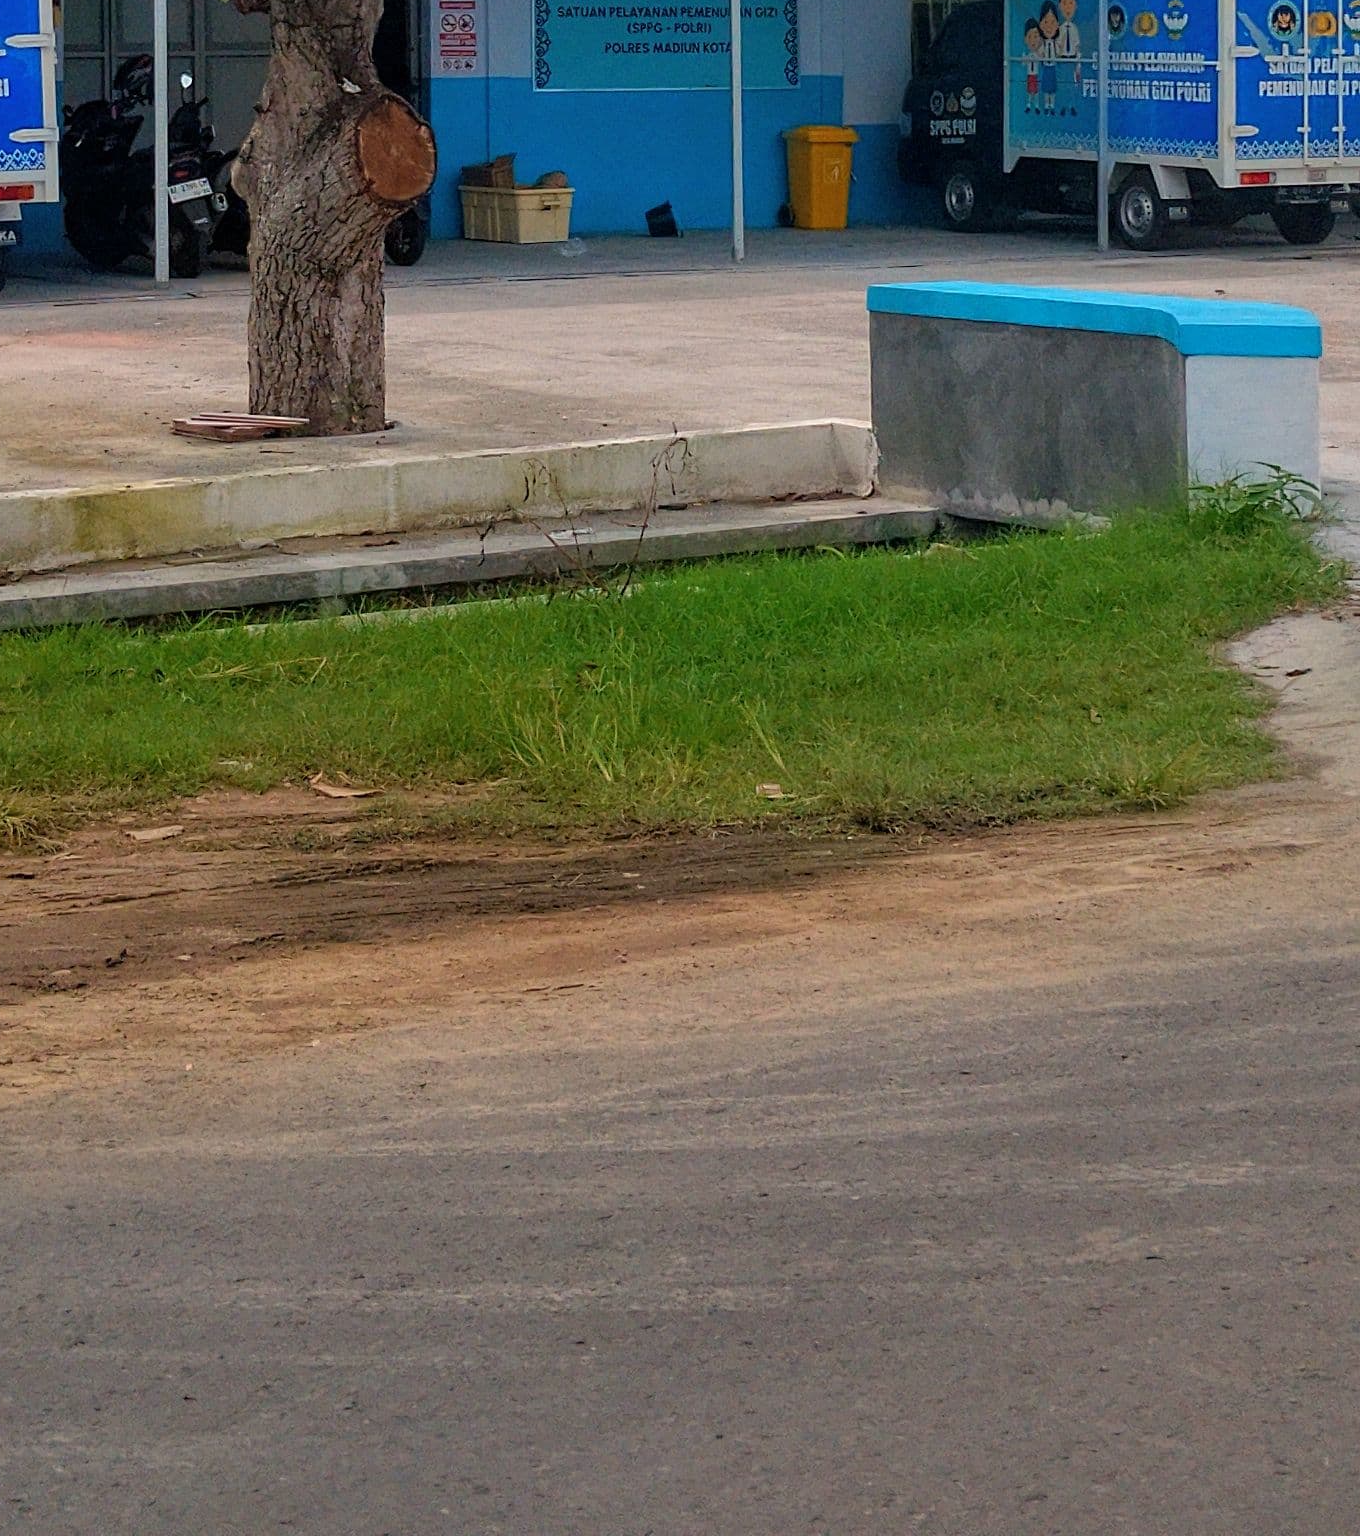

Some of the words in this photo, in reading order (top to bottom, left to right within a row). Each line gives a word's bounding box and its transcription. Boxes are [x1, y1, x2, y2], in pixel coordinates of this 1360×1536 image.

[557, 6, 607, 18] SATUAN
[609, 7, 678, 18] PELAYANAN
[681, 7, 752, 18] PEMENUAN
[755, 7, 778, 18] GIZI
[627, 22, 663, 35] (SPPG
[674, 22, 712, 35] POLRI)
[605, 43, 650, 54] POLRES
[653, 43, 700, 54] MADIUN
[703, 43, 734, 54] KOTA
[1083, 79, 1149, 99] PEENUHAN
[1152, 80, 1174, 101] GIZI
[1177, 81, 1211, 102] POLRI
